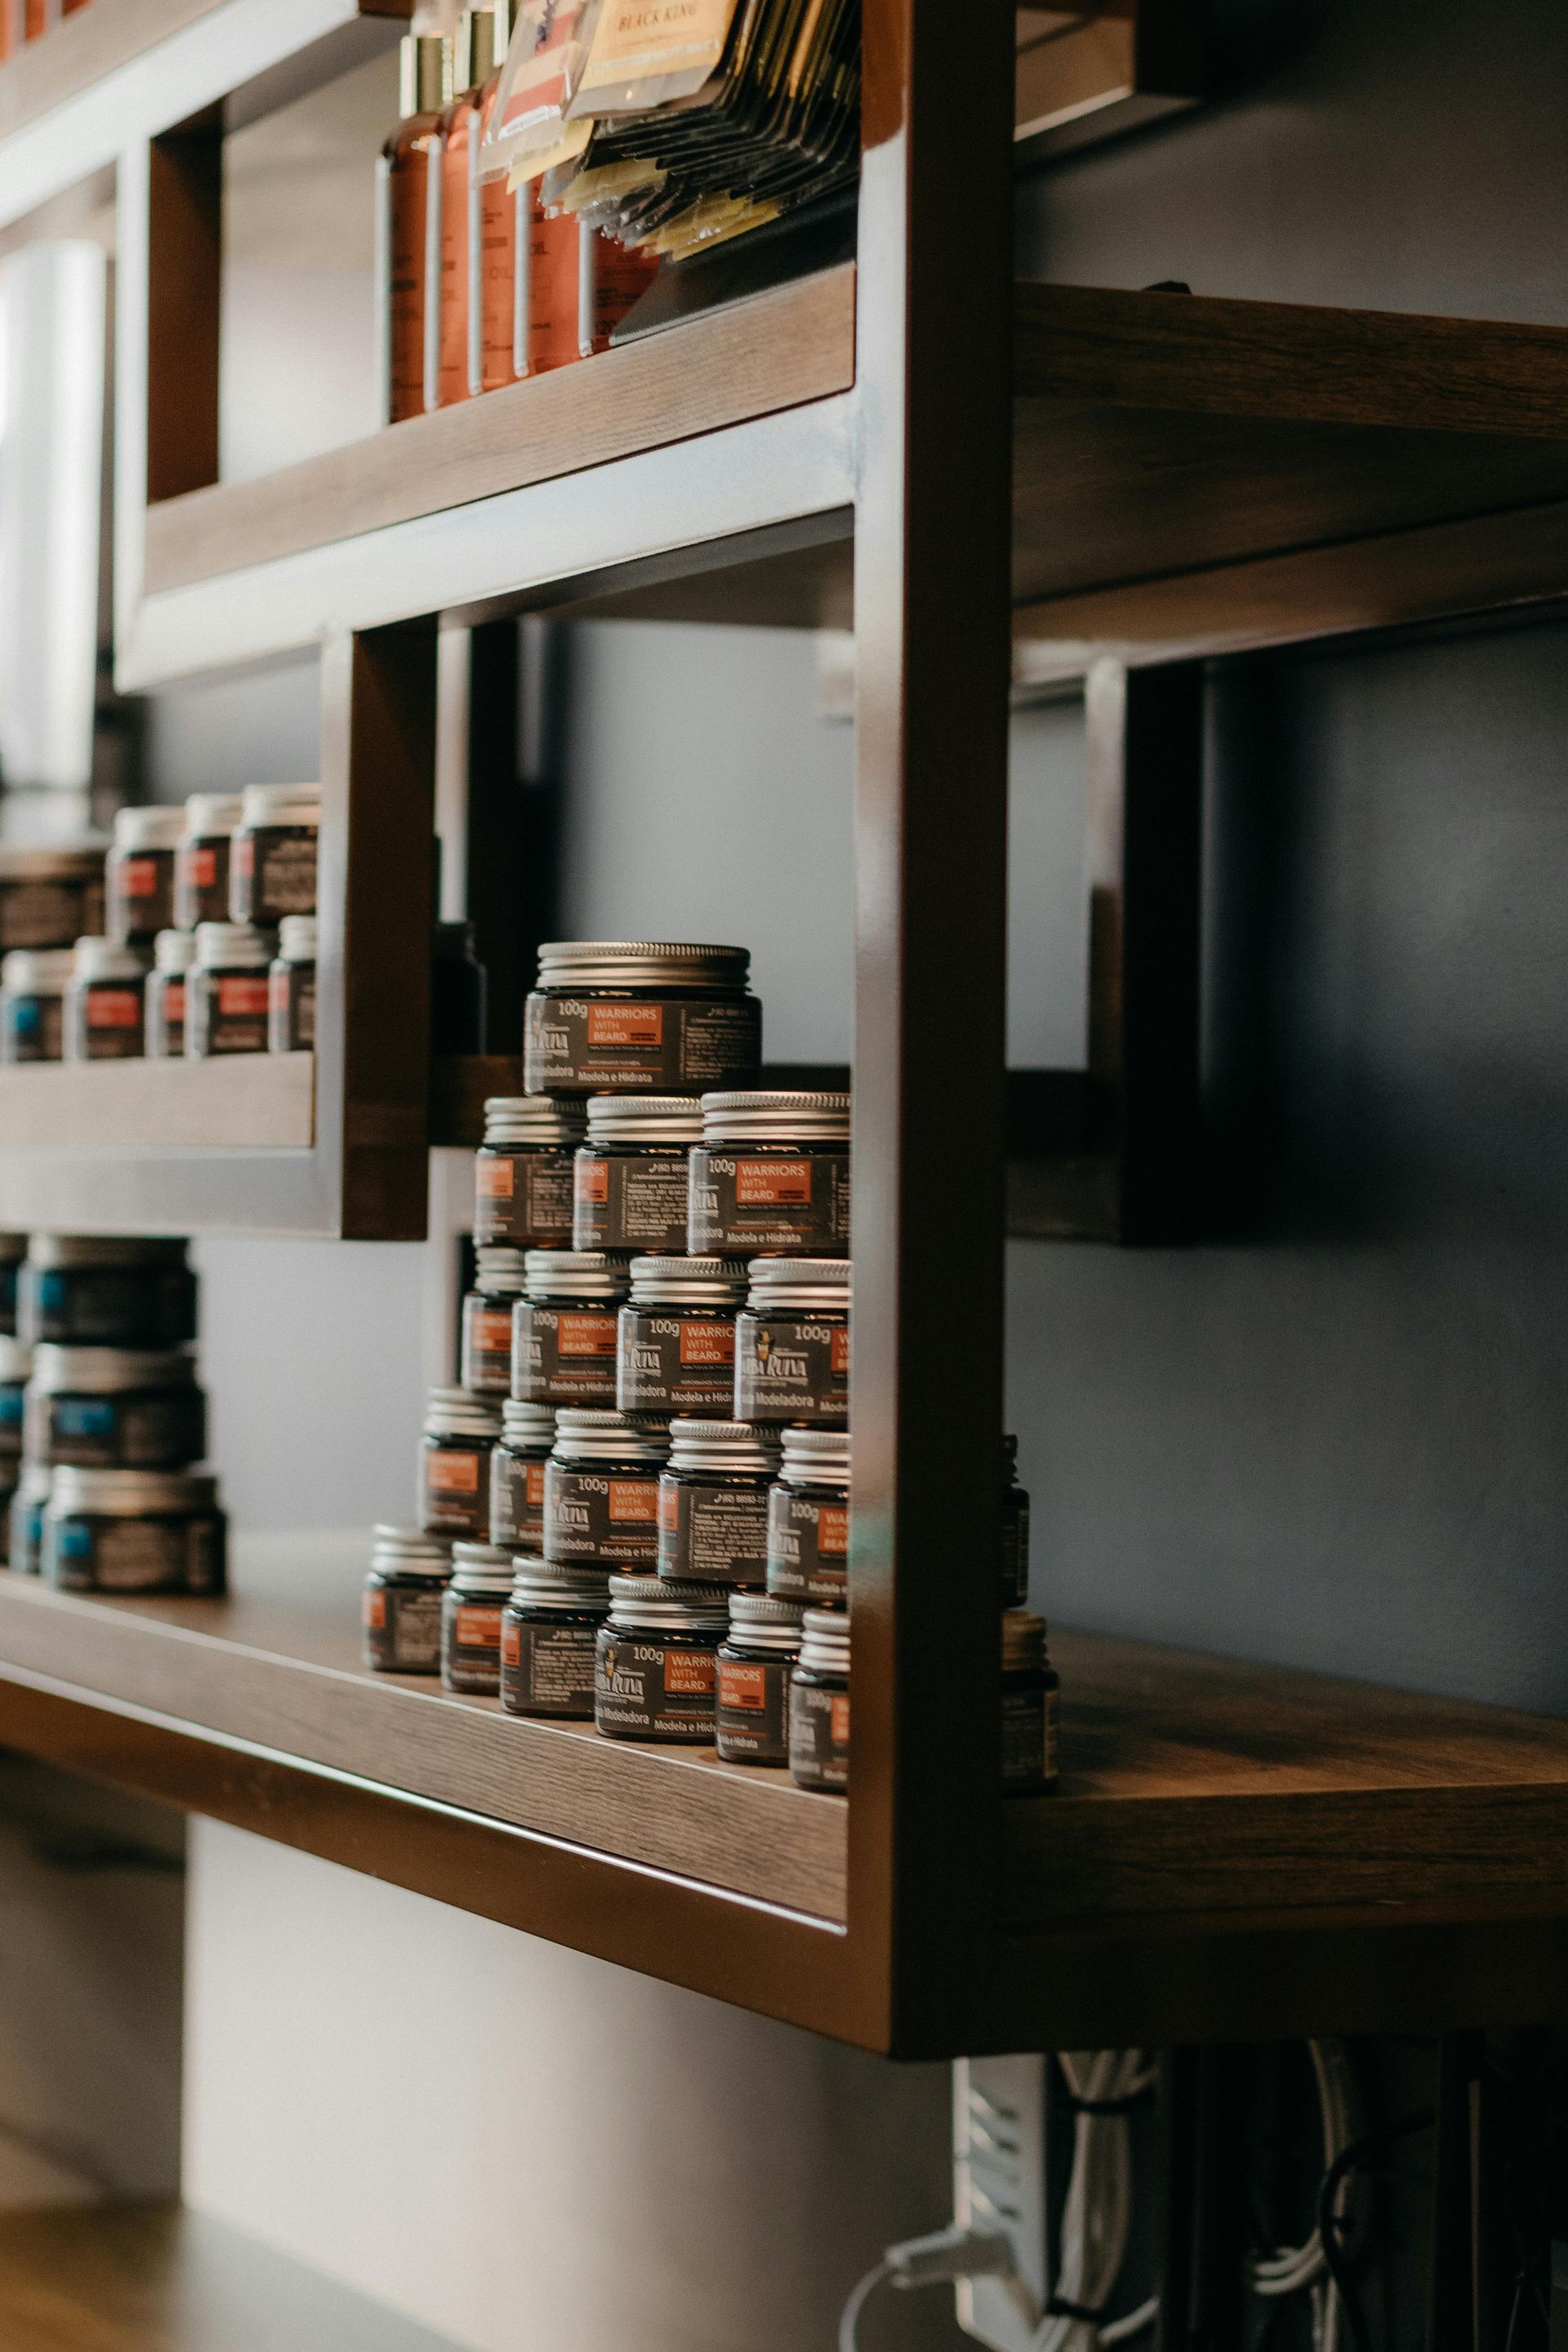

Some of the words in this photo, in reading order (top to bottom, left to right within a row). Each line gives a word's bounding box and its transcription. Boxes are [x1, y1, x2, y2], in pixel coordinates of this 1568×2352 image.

[619, 11, 661, 32] BLACK
[664, 2, 698, 20] KING
[559, 1000, 588, 1019] 100g
[595, 1008, 657, 1020] WARRIORS
[595, 1020, 621, 1031] WITH
[594, 1031, 628, 1042] BEARD
[577, 1071, 610, 1083] Modela
[611, 1074, 618, 1083] e
[619, 1071, 653, 1084] Hidrata
[709, 1160, 736, 1176] 100g
[742, 1165, 805, 1177] WARRIORS
[742, 1178, 767, 1187] WITH
[741, 1190, 774, 1200] BEARD
[728, 1232, 758, 1243] Modela
[759, 1235, 765, 1243] e
[766, 1232, 802, 1244] Hidrata
[533, 1312, 559, 1329] 100g
[564, 1319, 617, 1330] WARRIOR
[650, 1320, 680, 1337] 100g
[687, 1326, 735, 1338] WARRIO
[795, 1325, 831, 1344] 100g
[562, 1342, 595, 1352] BEARD
[687, 1339, 713, 1348] WITH
[686, 1351, 721, 1361] BEARD
[671, 1391, 704, 1402] Modela
[705, 1394, 711, 1402] e
[578, 1478, 608, 1495] 100g
[615, 1497, 642, 1506] WITH
[614, 1508, 650, 1517] BEARD
[599, 1545, 633, 1557] Modela
[633, 1548, 640, 1557] e
[634, 1646, 664, 1665] 100g
[671, 1668, 698, 1678] WITH
[670, 1680, 706, 1690] BEARD
[654, 1719, 688, 1731] Modela
[688, 1723, 695, 1731] e
